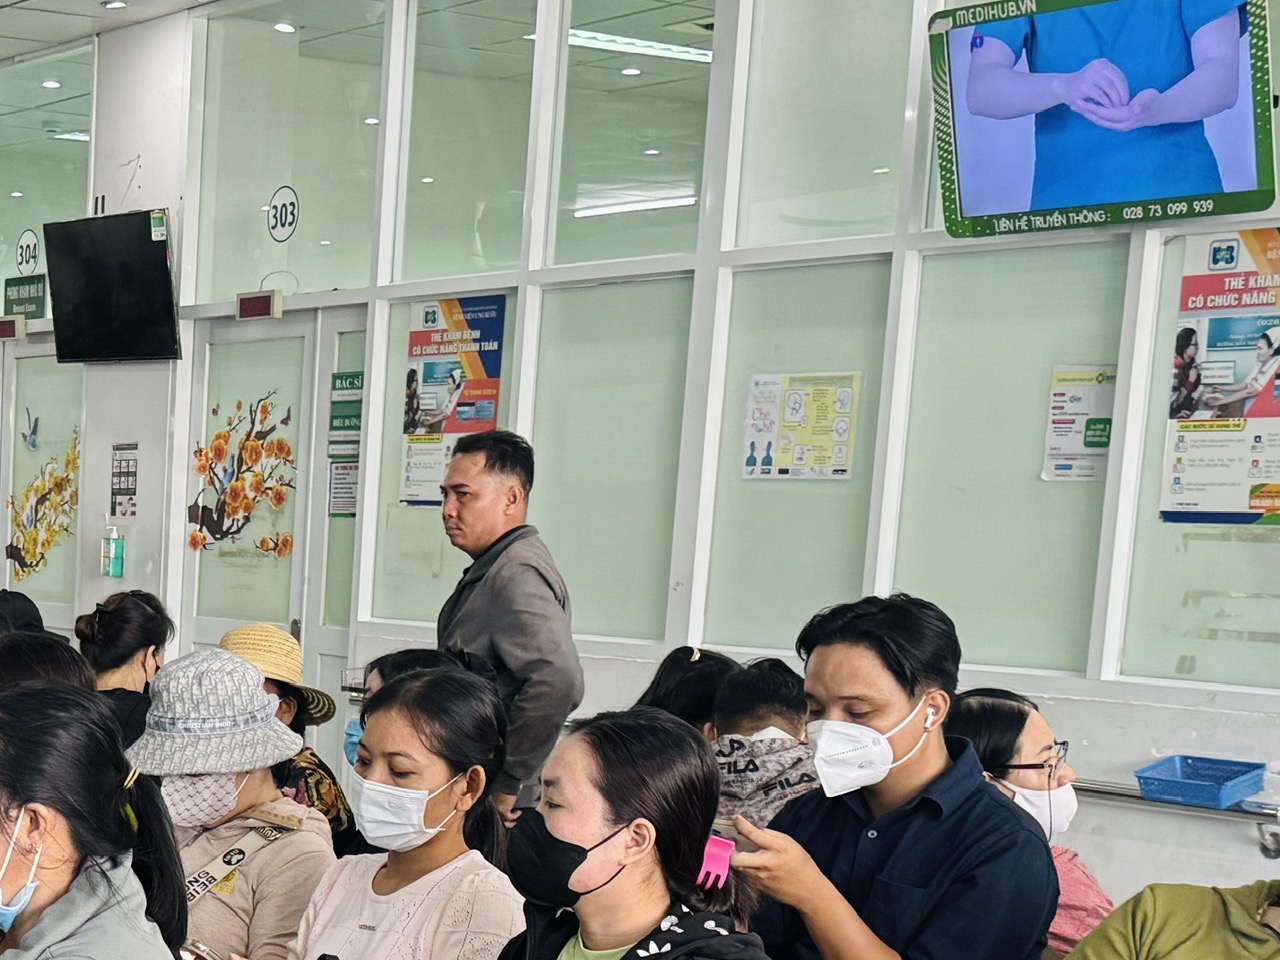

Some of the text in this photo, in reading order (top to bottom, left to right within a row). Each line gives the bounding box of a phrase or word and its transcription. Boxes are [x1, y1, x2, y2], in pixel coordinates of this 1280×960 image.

[956, 0, 1037, 26] MEDIHUB.VN
[271, 202, 296, 231] 303
[1123, 206, 1143, 220] 028
[1148, 204, 1163, 217] 73
[1167, 202, 1188, 216] 099
[1193, 200, 1214, 214] 939
[18, 243, 37, 266] 304
[1188, 295, 1204, 308] CÓ
[1207, 293, 1239, 307] CHỨC
[335, 376, 352, 389] BÁC
[762, 772, 816, 797] FILA
